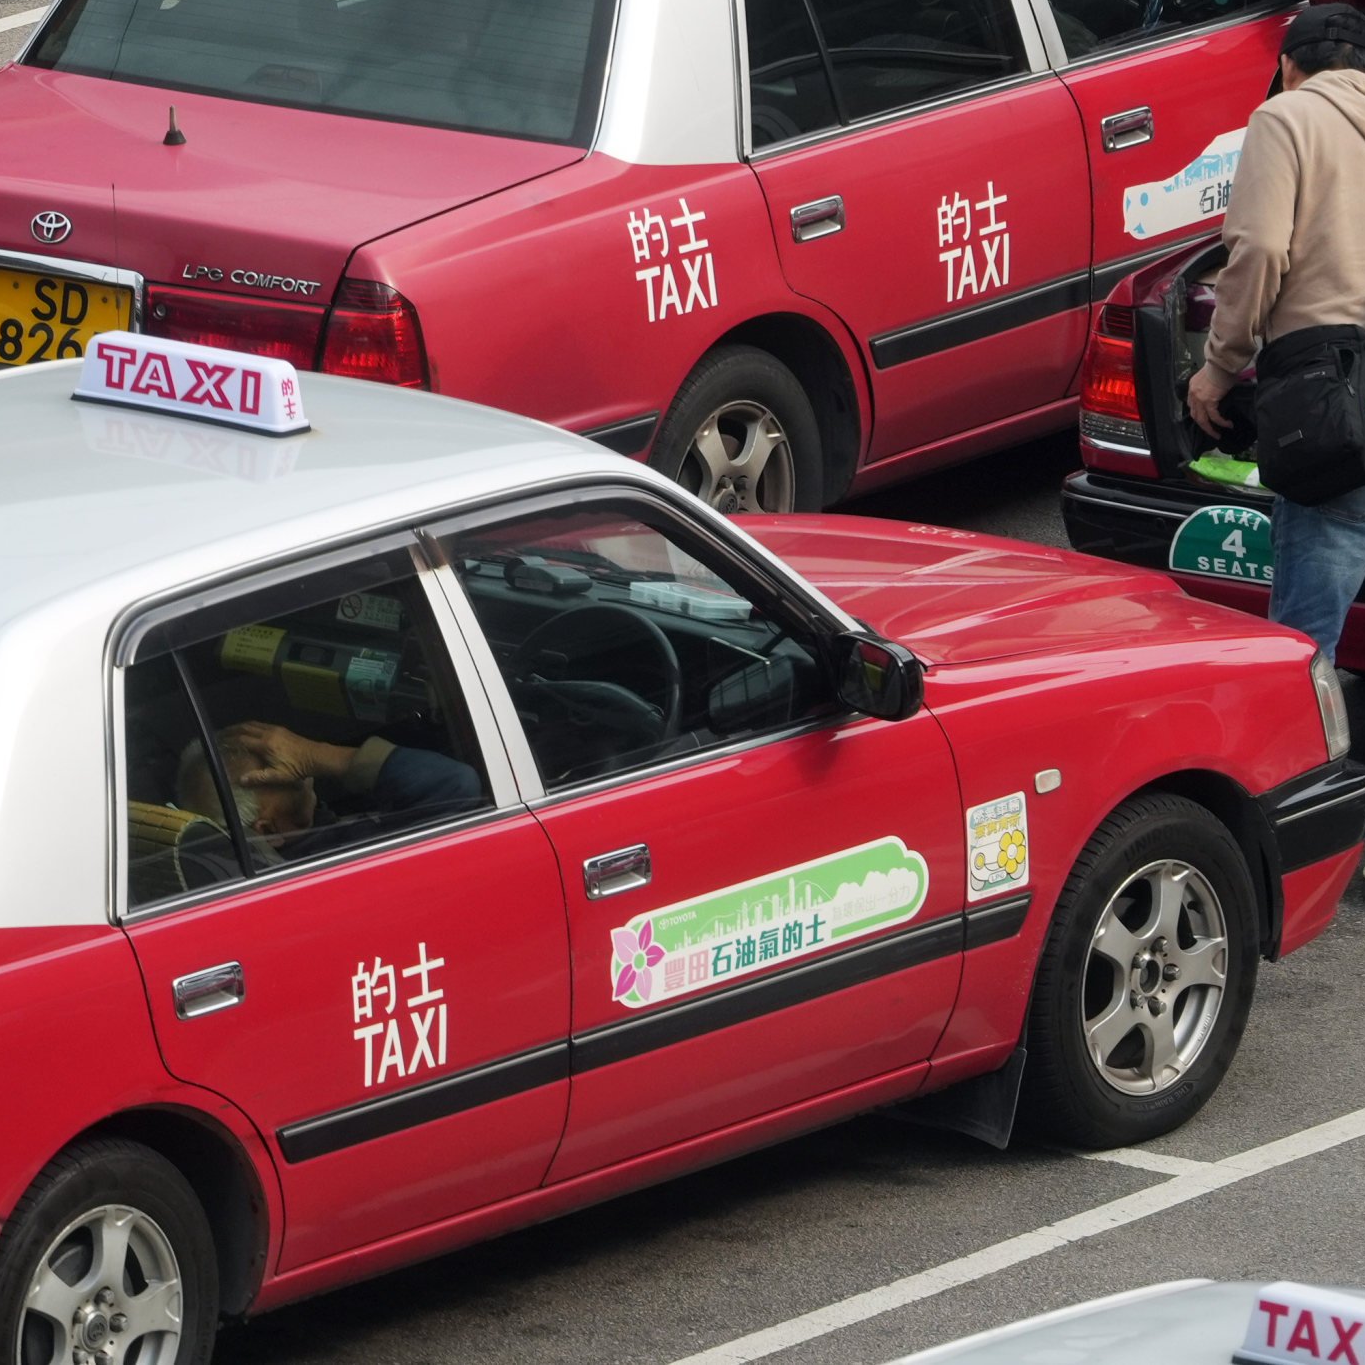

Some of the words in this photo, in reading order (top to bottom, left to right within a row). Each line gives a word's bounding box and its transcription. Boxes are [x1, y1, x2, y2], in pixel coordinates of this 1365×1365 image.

[627, 198, 709, 263] 的士
[938, 180, 1007, 246] 的士
[182, 263, 223, 281] LPG
[230, 269, 322, 296] COMFORT
[635, 252, 718, 323] TAXI
[939, 233, 1010, 303] TAXI
[31, 278, 88, 326] SD
[96, 343, 262, 416] TAXI
[281, 378, 295, 420] 的士
[1207, 509, 1263, 532] TAXI
[1221, 529, 1247, 558] 4
[1197, 556, 1275, 580] SEATS
[351, 942, 446, 1024] 的士
[664, 913, 827, 993] 豐田石油氣的士
[354, 1004, 447, 1088] TAXI
